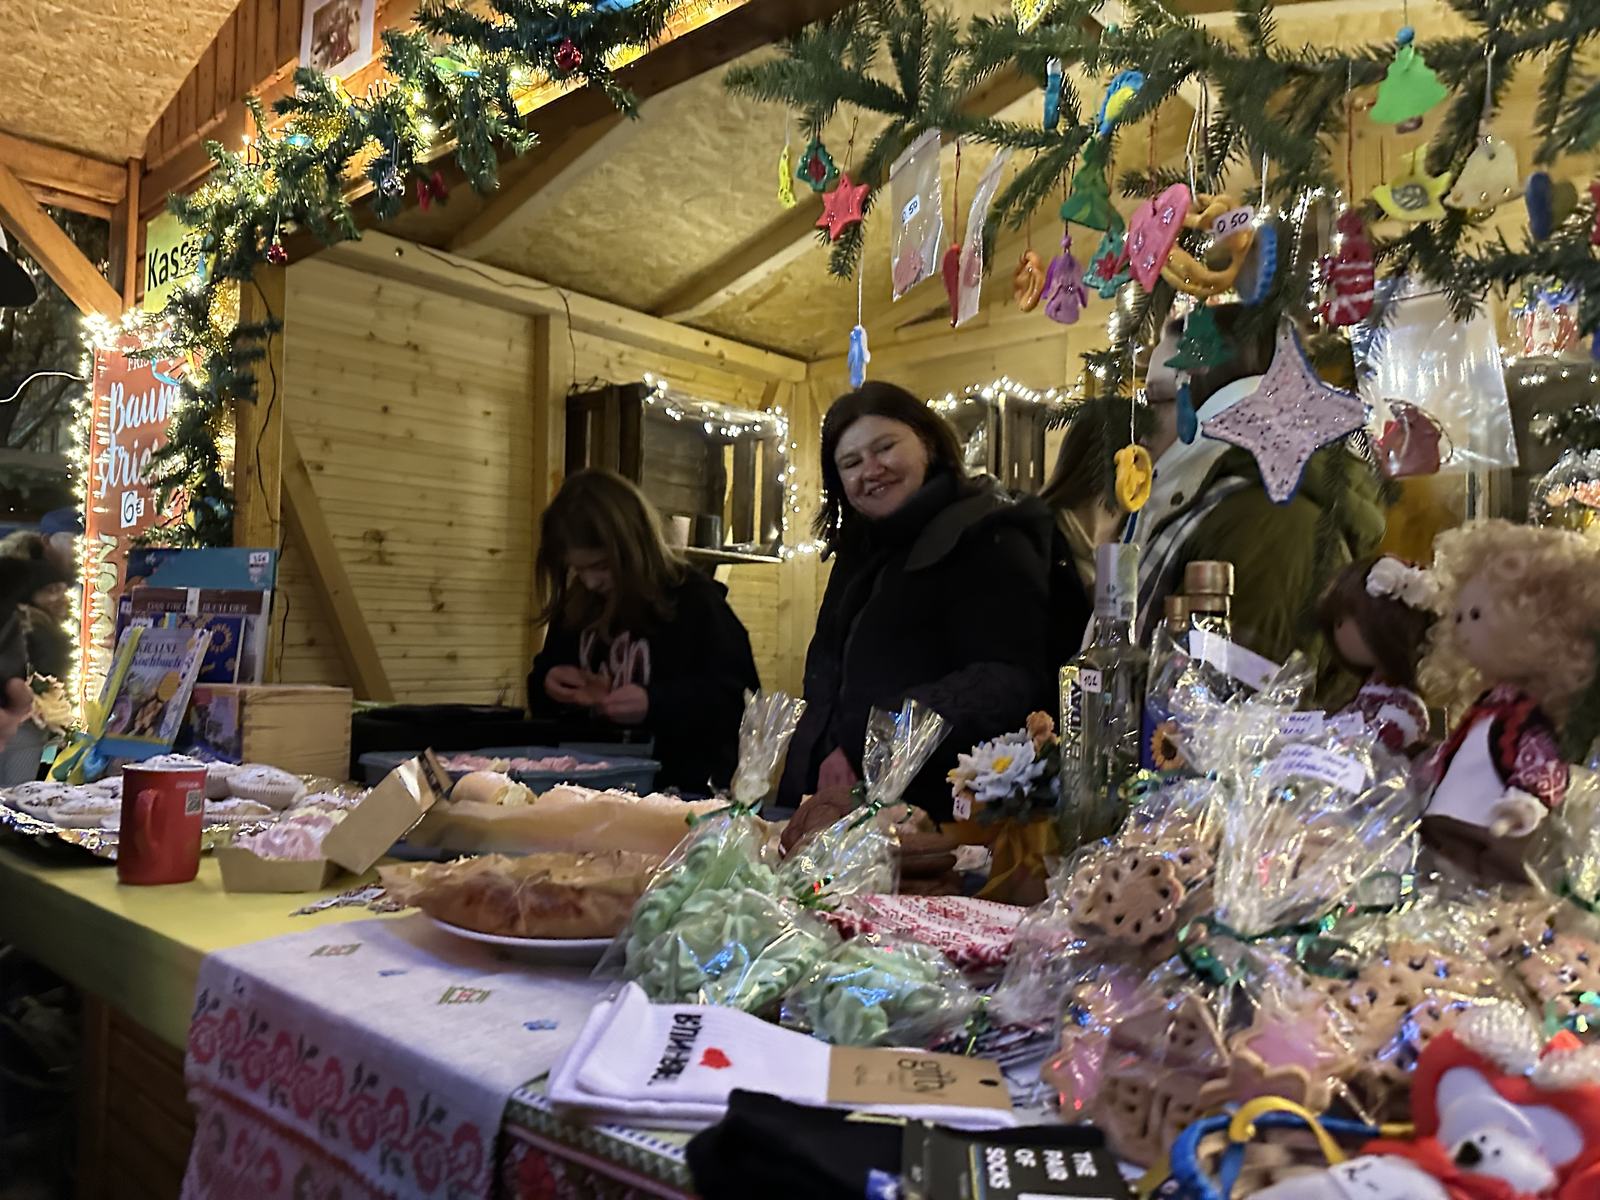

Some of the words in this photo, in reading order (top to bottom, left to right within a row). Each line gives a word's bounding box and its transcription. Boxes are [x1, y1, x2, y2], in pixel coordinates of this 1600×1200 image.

[147, 240, 198, 292] Kass
[124, 492, 142, 523] 6€
[985, 1147, 1012, 1190] SOCKS
[1014, 1148, 1037, 1168] OF
[1042, 1149, 1069, 1181] PAIR
